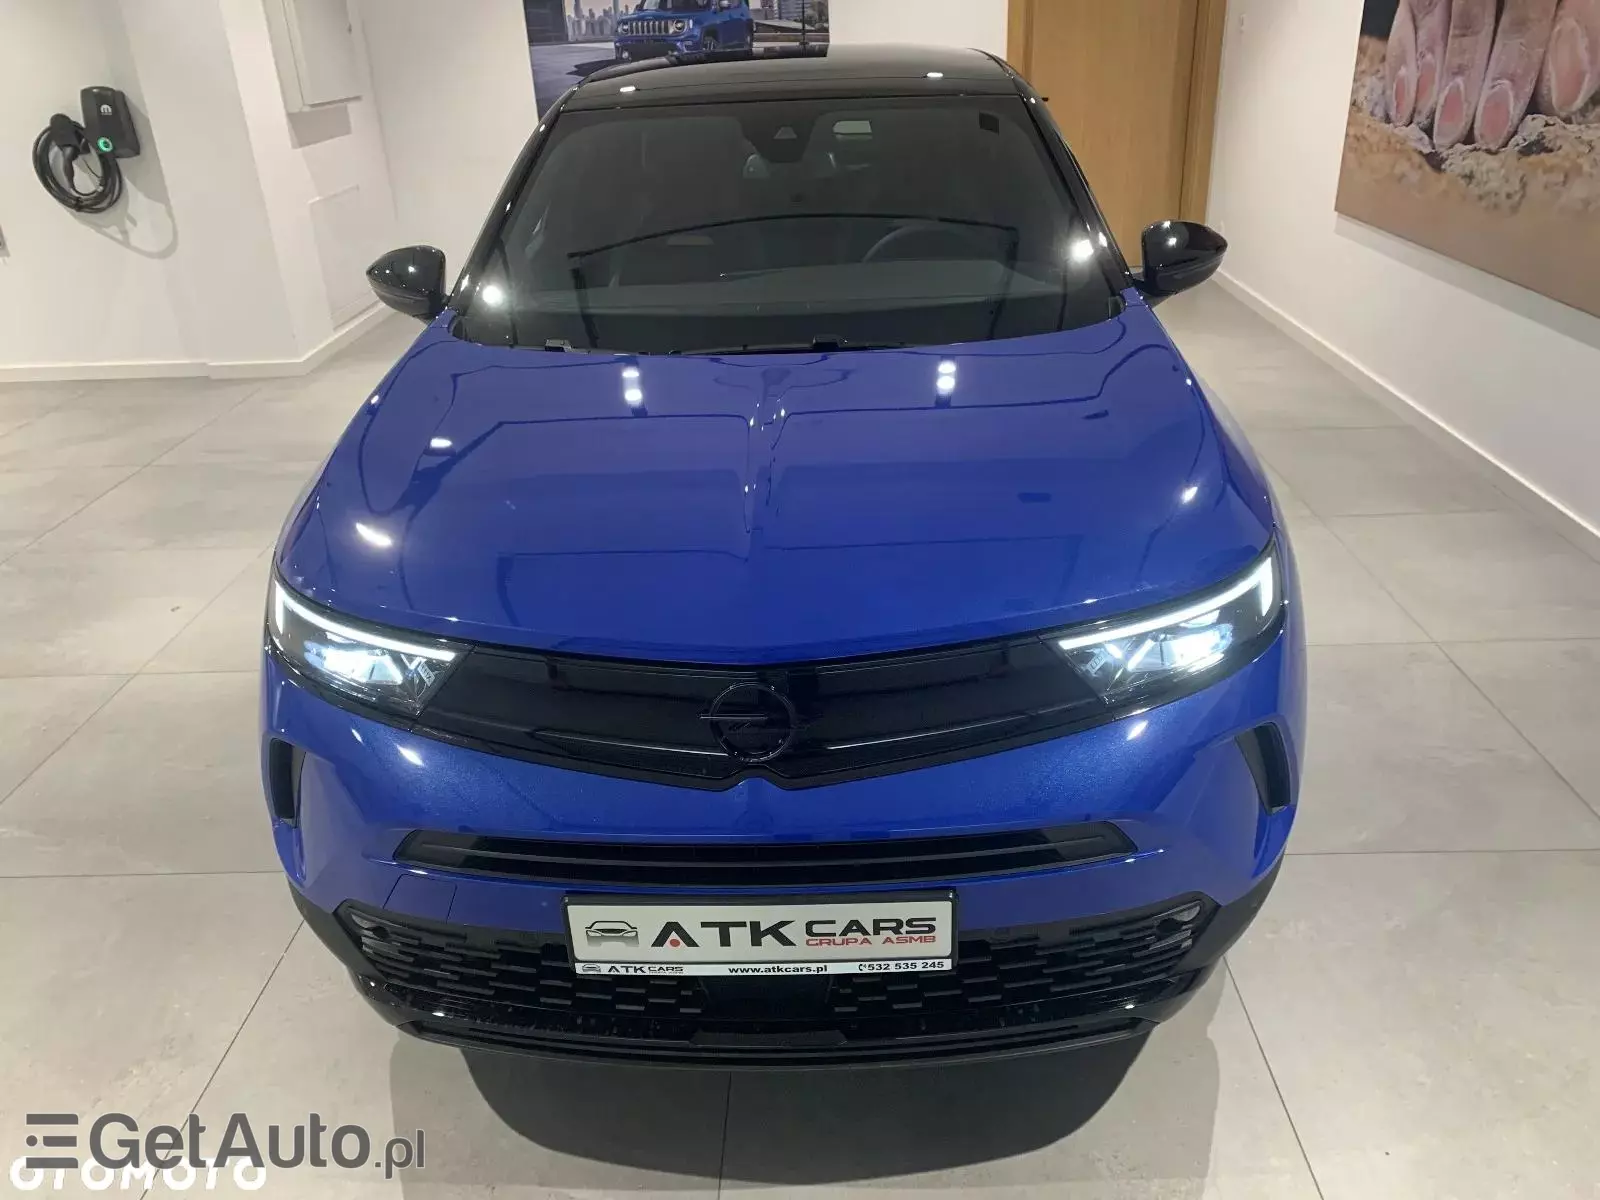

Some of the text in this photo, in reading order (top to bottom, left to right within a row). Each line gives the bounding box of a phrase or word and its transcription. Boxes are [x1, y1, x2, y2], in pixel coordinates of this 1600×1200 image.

[651, 917, 937, 948] ATK CARS
[805, 935, 937, 947] GRUPA ASMB
[607, 965, 646, 974] ATK
[728, 964, 828, 974] www.atkcars.pl
[867, 961, 945, 971] 532 535 245
